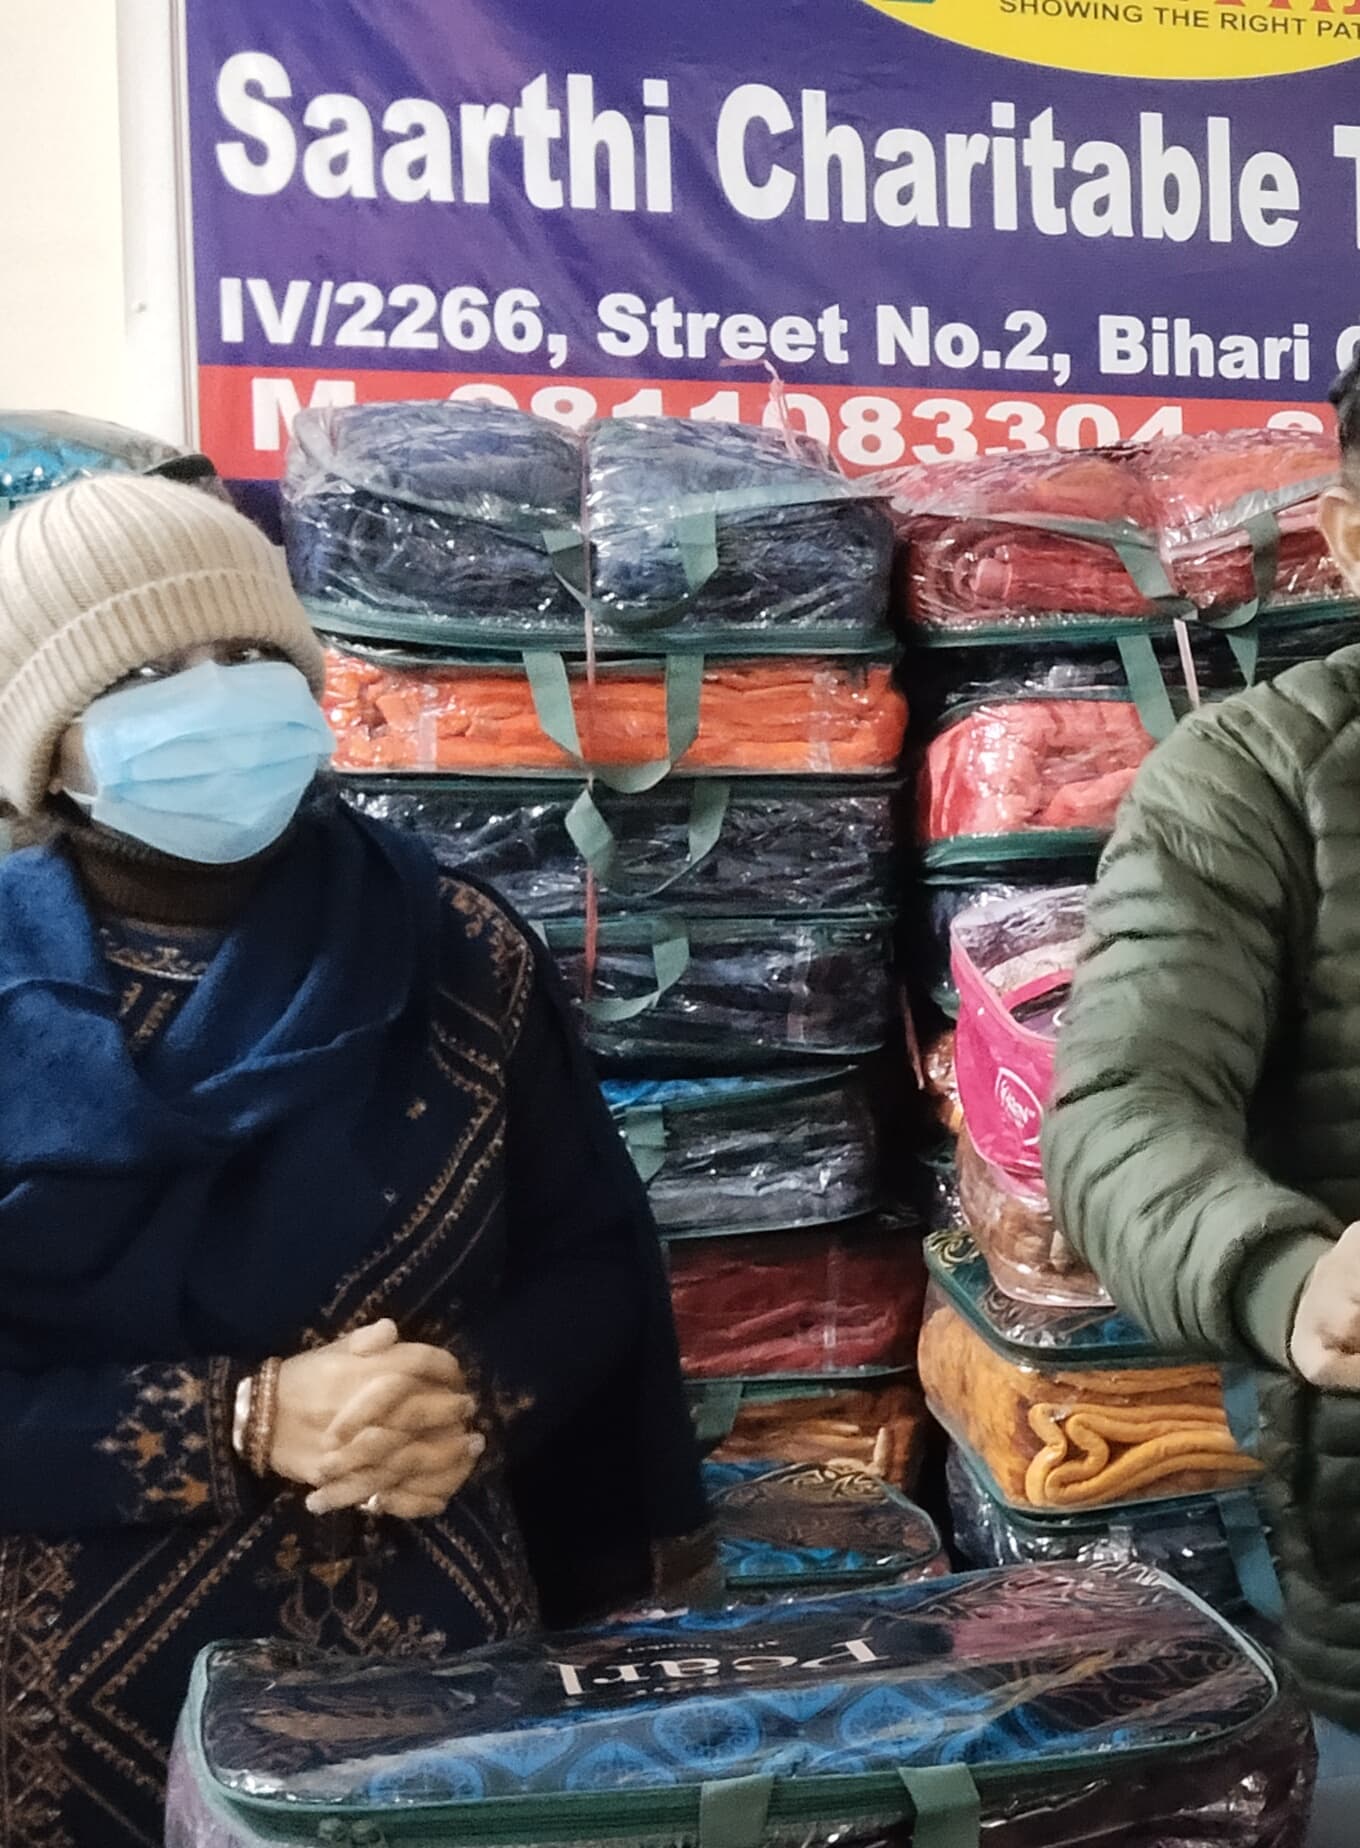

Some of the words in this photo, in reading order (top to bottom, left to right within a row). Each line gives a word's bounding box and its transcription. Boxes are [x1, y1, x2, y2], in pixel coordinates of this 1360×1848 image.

[1000, 0, 1143, 23] SHOWING
[1154, 7, 1210, 29] THE
[1220, 14, 1306, 36] RIGHT
[215, 51, 674, 213] Saarthi
[716, 83, 1300, 247] Charitable
[220, 277, 569, 369] IV/2266,
[598, 293, 849, 363] Street
[877, 305, 1073, 387] No.2,
[1100, 313, 1310, 382] Bihari
[546, 1636, 890, 1697] Pearl
